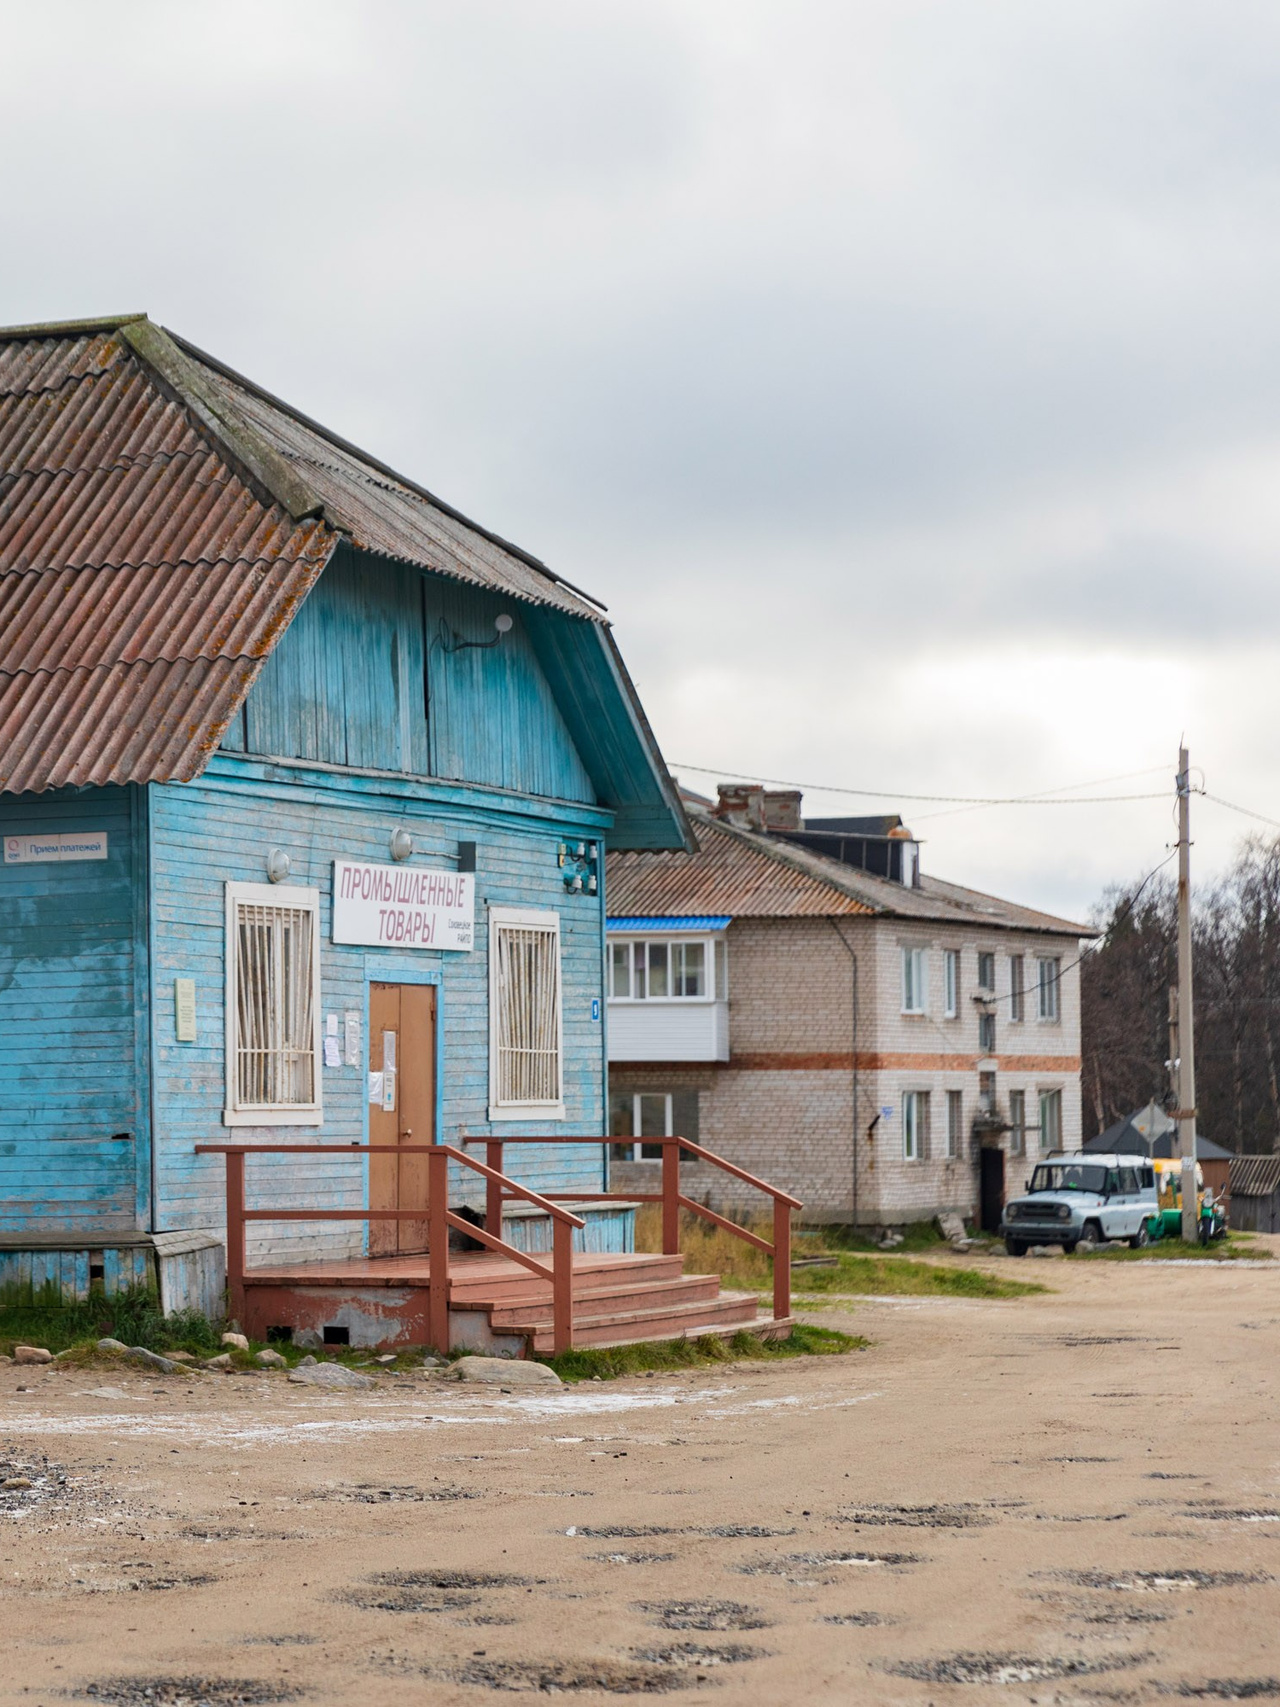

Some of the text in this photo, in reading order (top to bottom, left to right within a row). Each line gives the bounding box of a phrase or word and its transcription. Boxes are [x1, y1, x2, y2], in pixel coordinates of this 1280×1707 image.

[29, 842, 102, 856] Прием платежей
[340, 867, 465, 908] ПРОМЫШЛЕННЫЕ
[379, 909, 436, 944] ТОВАРЫ
